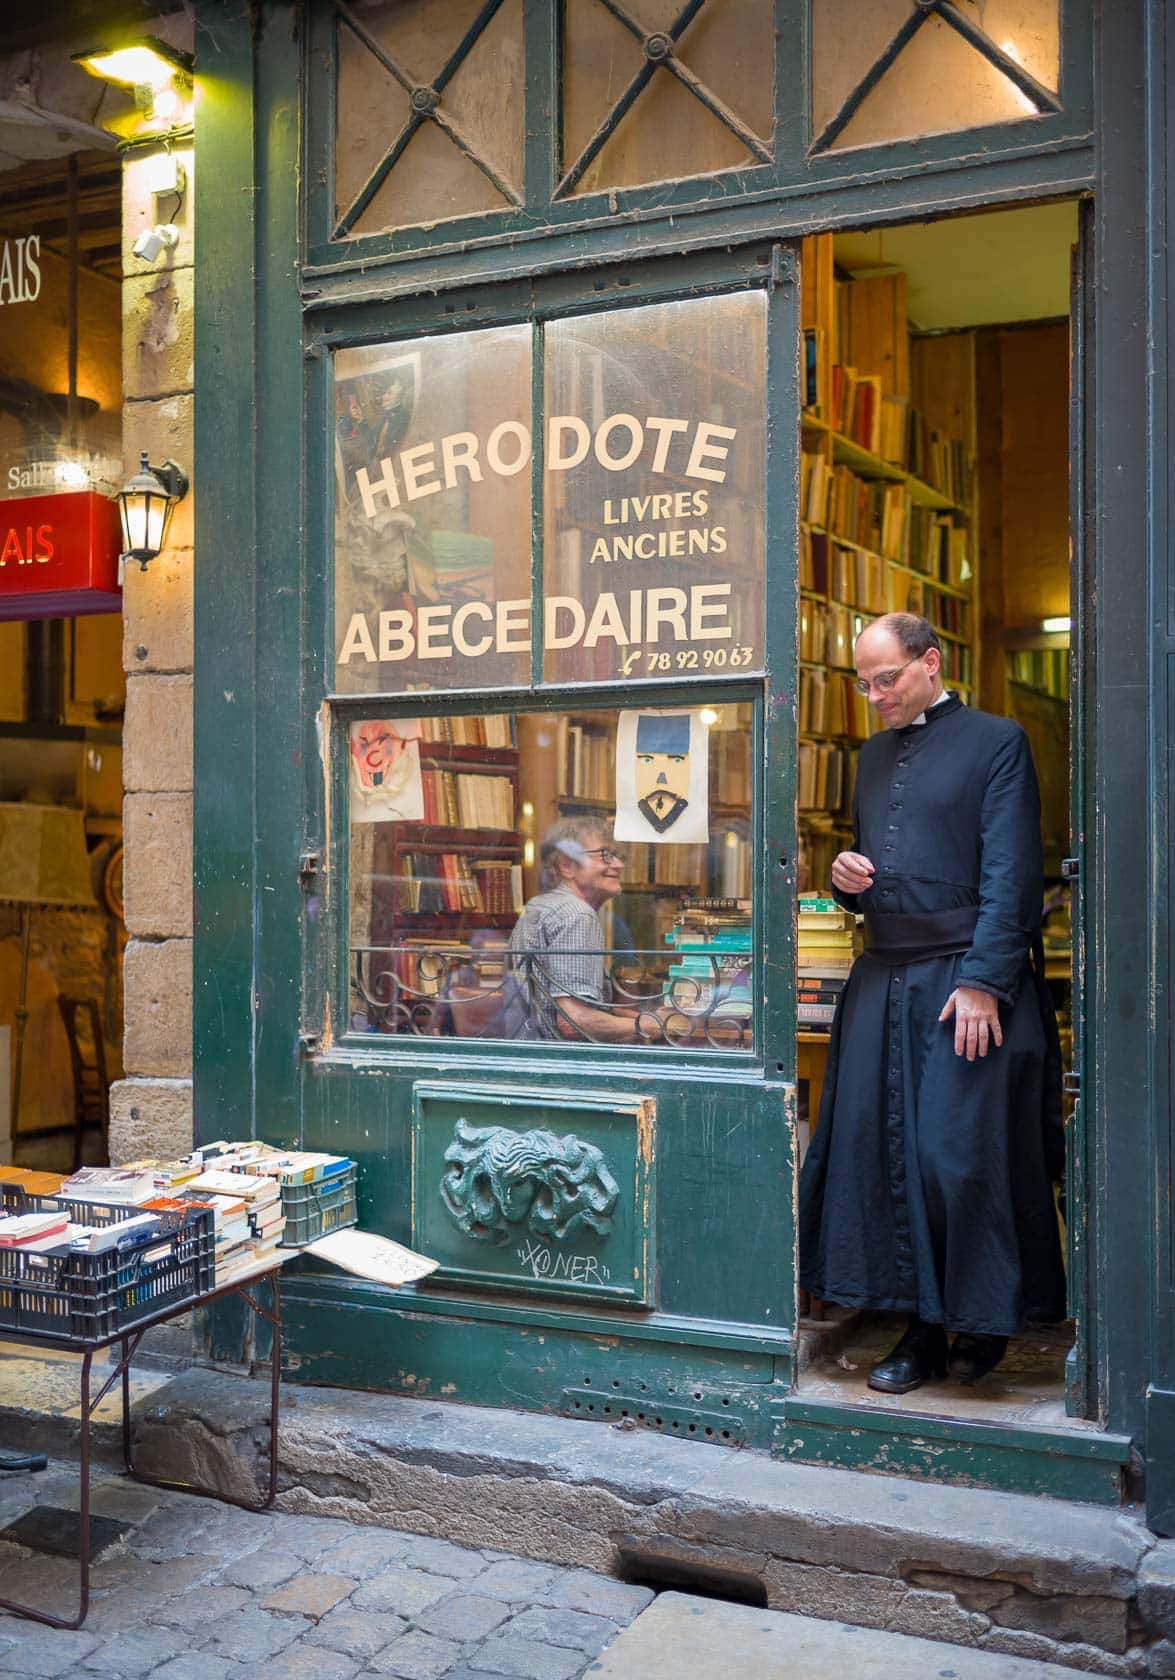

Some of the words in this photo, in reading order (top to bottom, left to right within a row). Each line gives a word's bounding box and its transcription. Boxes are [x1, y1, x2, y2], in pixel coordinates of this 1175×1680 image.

[603, 489, 709, 526] LIVRES
[590, 526, 728, 564] ANCIENS
[647, 652, 671, 671] 78
[676, 650, 699, 669] 92
[702, 648, 727, 668] 90
